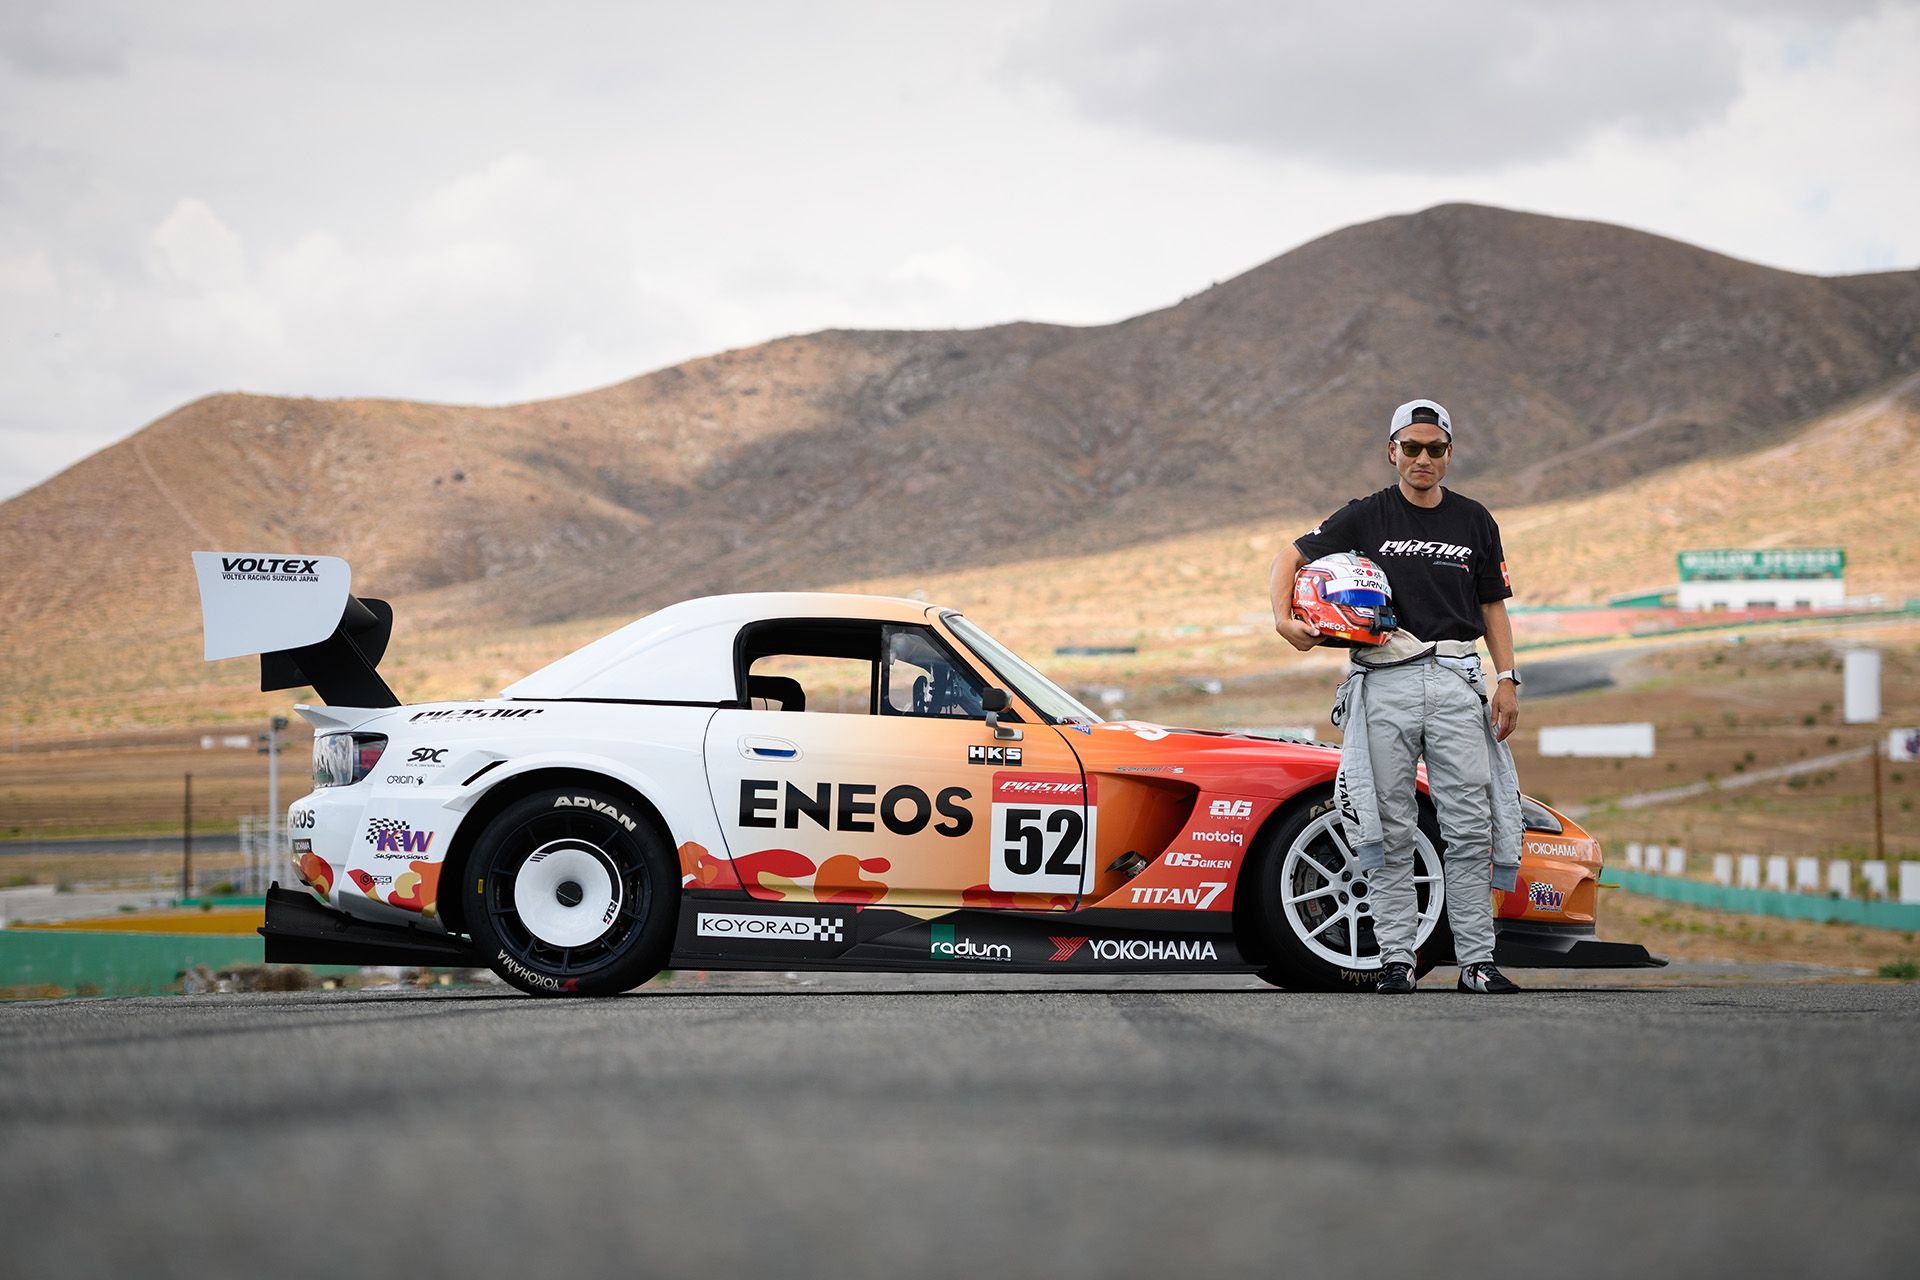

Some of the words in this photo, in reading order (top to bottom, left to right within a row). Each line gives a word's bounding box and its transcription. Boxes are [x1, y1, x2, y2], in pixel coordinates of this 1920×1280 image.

[221, 557, 319, 574] VOLTEX
[222, 573, 246, 581] VOLTEX
[1319, 620, 1347, 632] ENEOS
[407, 747, 449, 763] SDC
[969, 746, 1022, 762] HKS
[553, 796, 637, 832] ADVAN
[738, 779, 974, 838] ENEOS
[376, 830, 435, 852] KW
[1003, 808, 1085, 876] 52
[1192, 830, 1244, 847] motoiq
[1526, 842, 1578, 857] YOKOHAMA
[1131, 881, 1229, 910] TITAN7
[701, 918, 811, 936] KOYORAD
[930, 938, 1012, 959] radium
[1088, 939, 1218, 961] YOKOHAMA
[497, 949, 560, 990] YOKOHAMA
